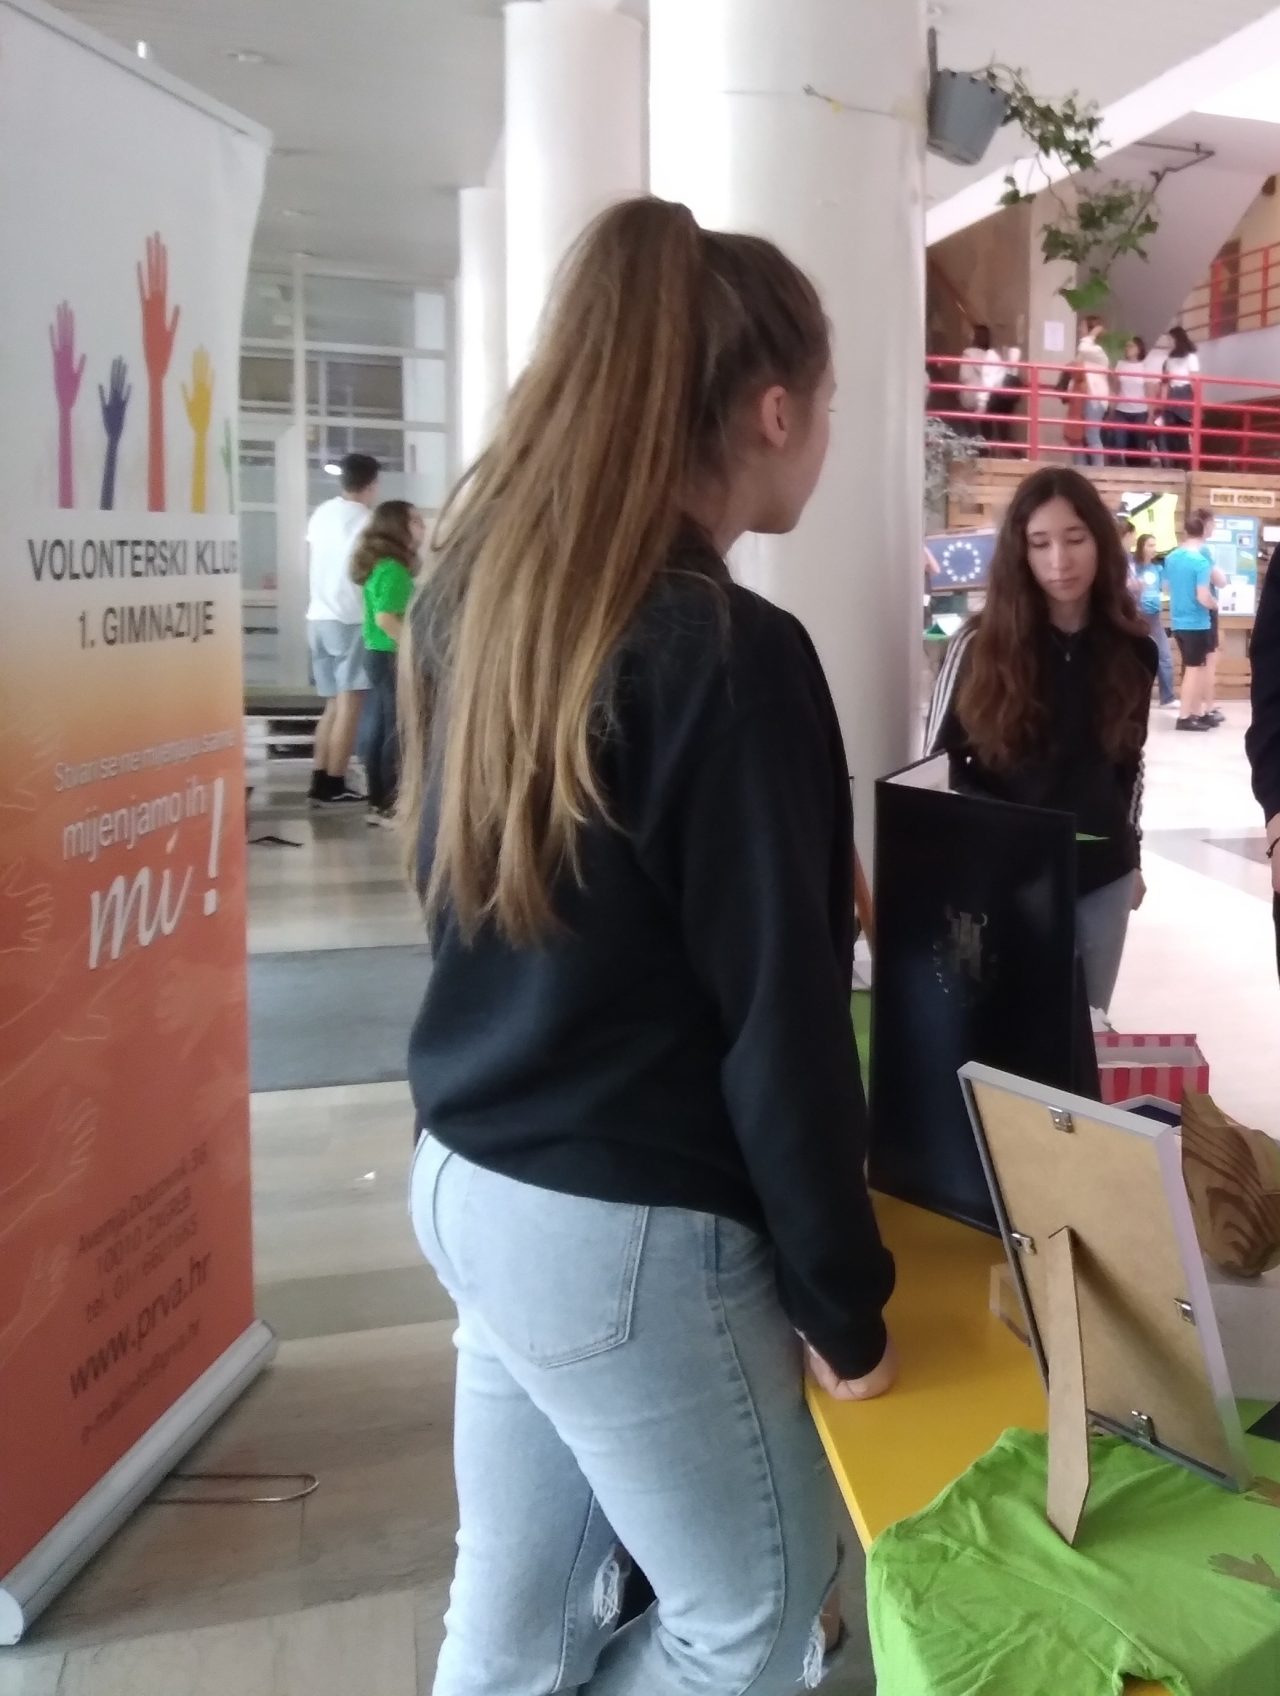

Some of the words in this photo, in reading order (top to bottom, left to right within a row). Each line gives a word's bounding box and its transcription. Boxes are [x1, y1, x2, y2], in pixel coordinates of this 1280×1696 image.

[27, 538, 189, 582] VOLONTERSKI
[195, 539, 238, 575] KLUB
[78, 610, 95, 650] 1.
[102, 601, 214, 646] GIMNAZIJE
[63, 790, 182, 863] mijenjamo
[185, 775, 207, 818] ih
[70, 1251, 211, 1400] www.prva.hr
